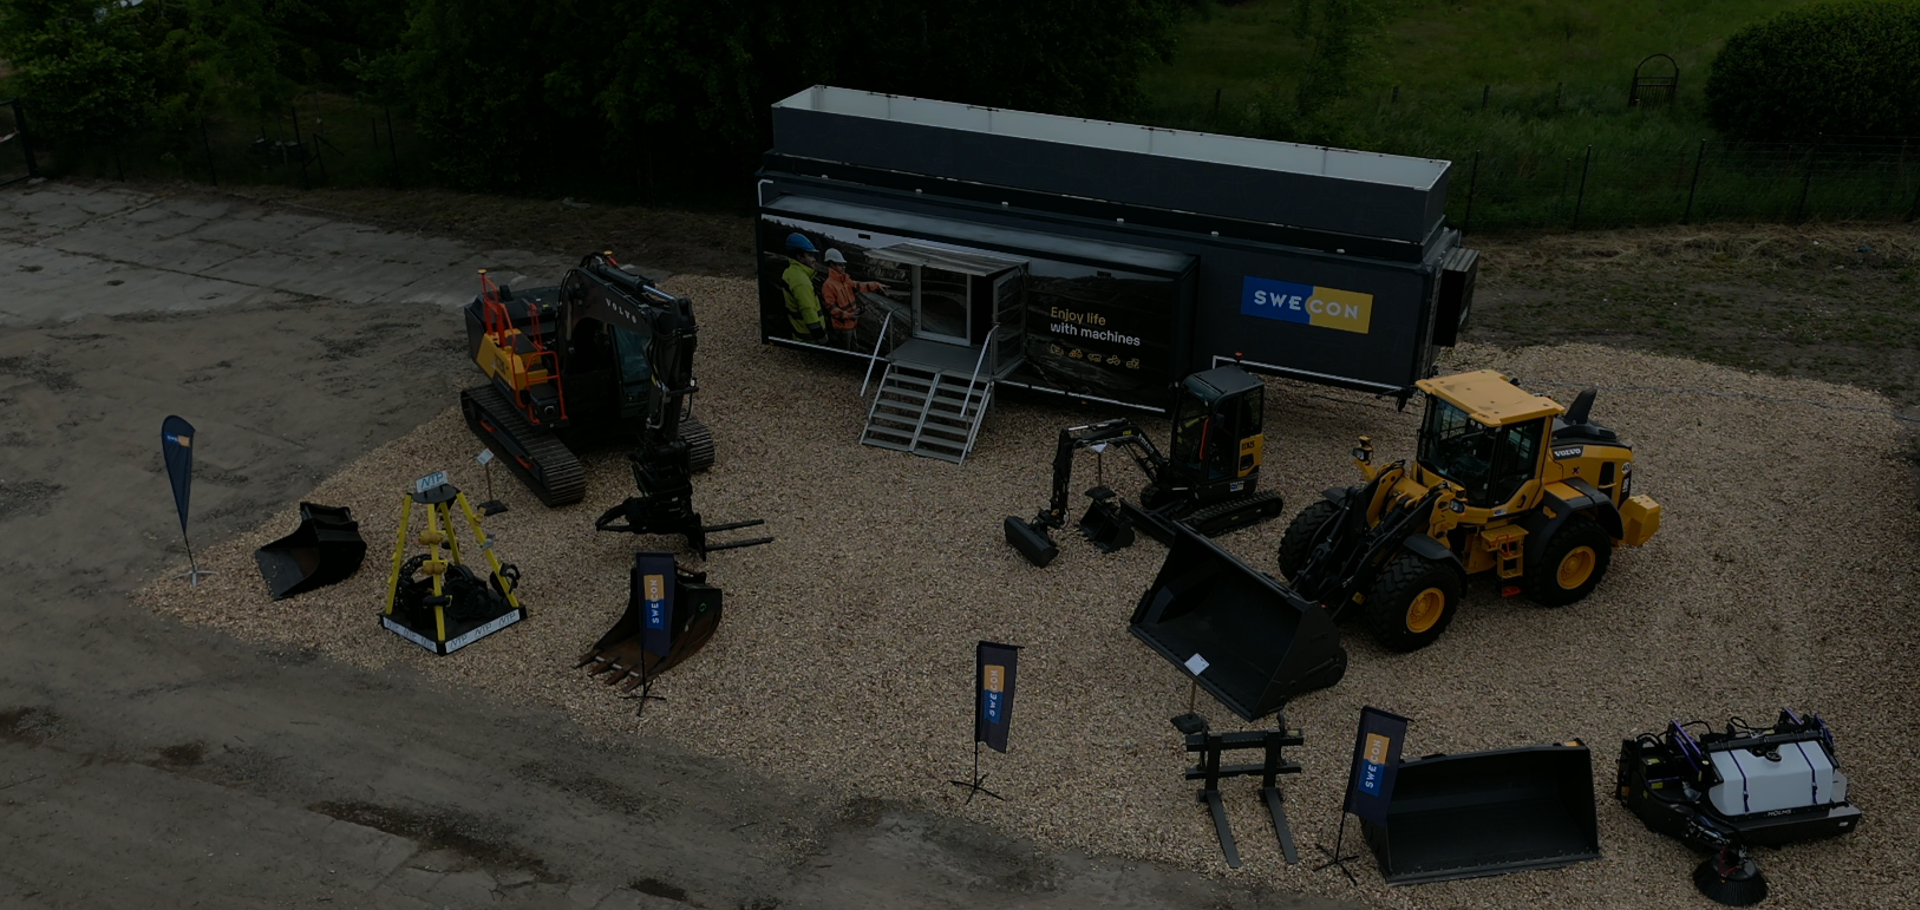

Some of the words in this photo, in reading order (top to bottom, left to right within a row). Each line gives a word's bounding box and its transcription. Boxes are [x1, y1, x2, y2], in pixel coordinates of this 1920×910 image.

[605, 297, 638, 324] VOLVO
[1050, 306, 1084, 325] Enjoy
[1086, 312, 1107, 326] life
[1253, 290, 1360, 320] SWECON
[1050, 322, 1078, 336] with
[1080, 327, 1141, 346] machines
[1553, 447, 1582, 457] VOLVO
[649, 580, 660, 624] SWECON
[988, 669, 999, 718] SWECON
[1364, 739, 1382, 789] SWECON
